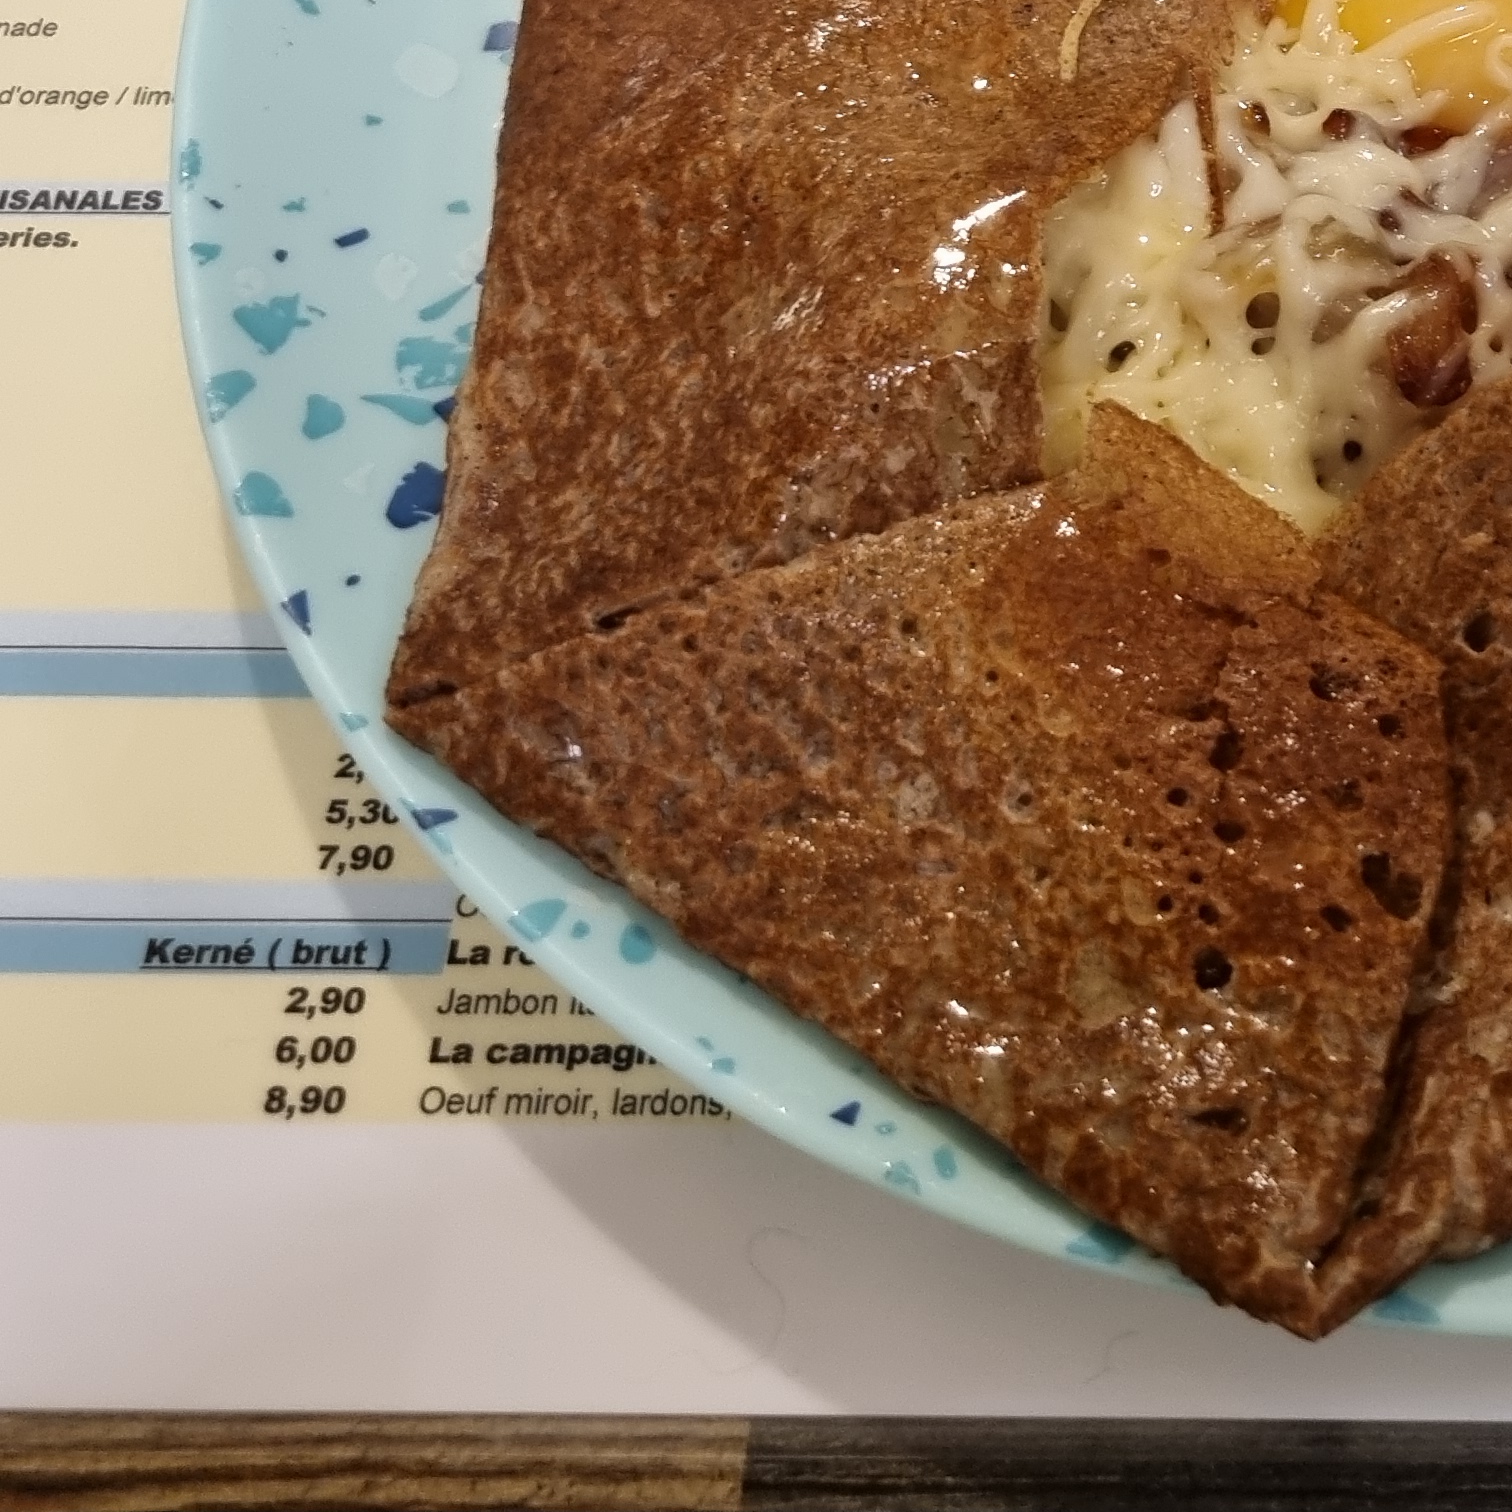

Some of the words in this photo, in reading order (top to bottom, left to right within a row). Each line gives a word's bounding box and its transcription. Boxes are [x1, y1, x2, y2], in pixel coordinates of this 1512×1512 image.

[0, 86, 109, 110] d'orange
[319, 845, 394, 876] 7,90
[144, 938, 255, 964] Kerné
[291, 939, 368, 965] brut
[447, 939, 490, 965] La
[284, 987, 366, 1020] 2,90
[437, 988, 558, 1015] Jambon
[275, 1036, 356, 1069] 6,00
[429, 1037, 474, 1064] La
[264, 1086, 346, 1120] 8,90
[419, 1086, 499, 1115] Oeuf
[504, 1088, 598, 1119] miroir,
